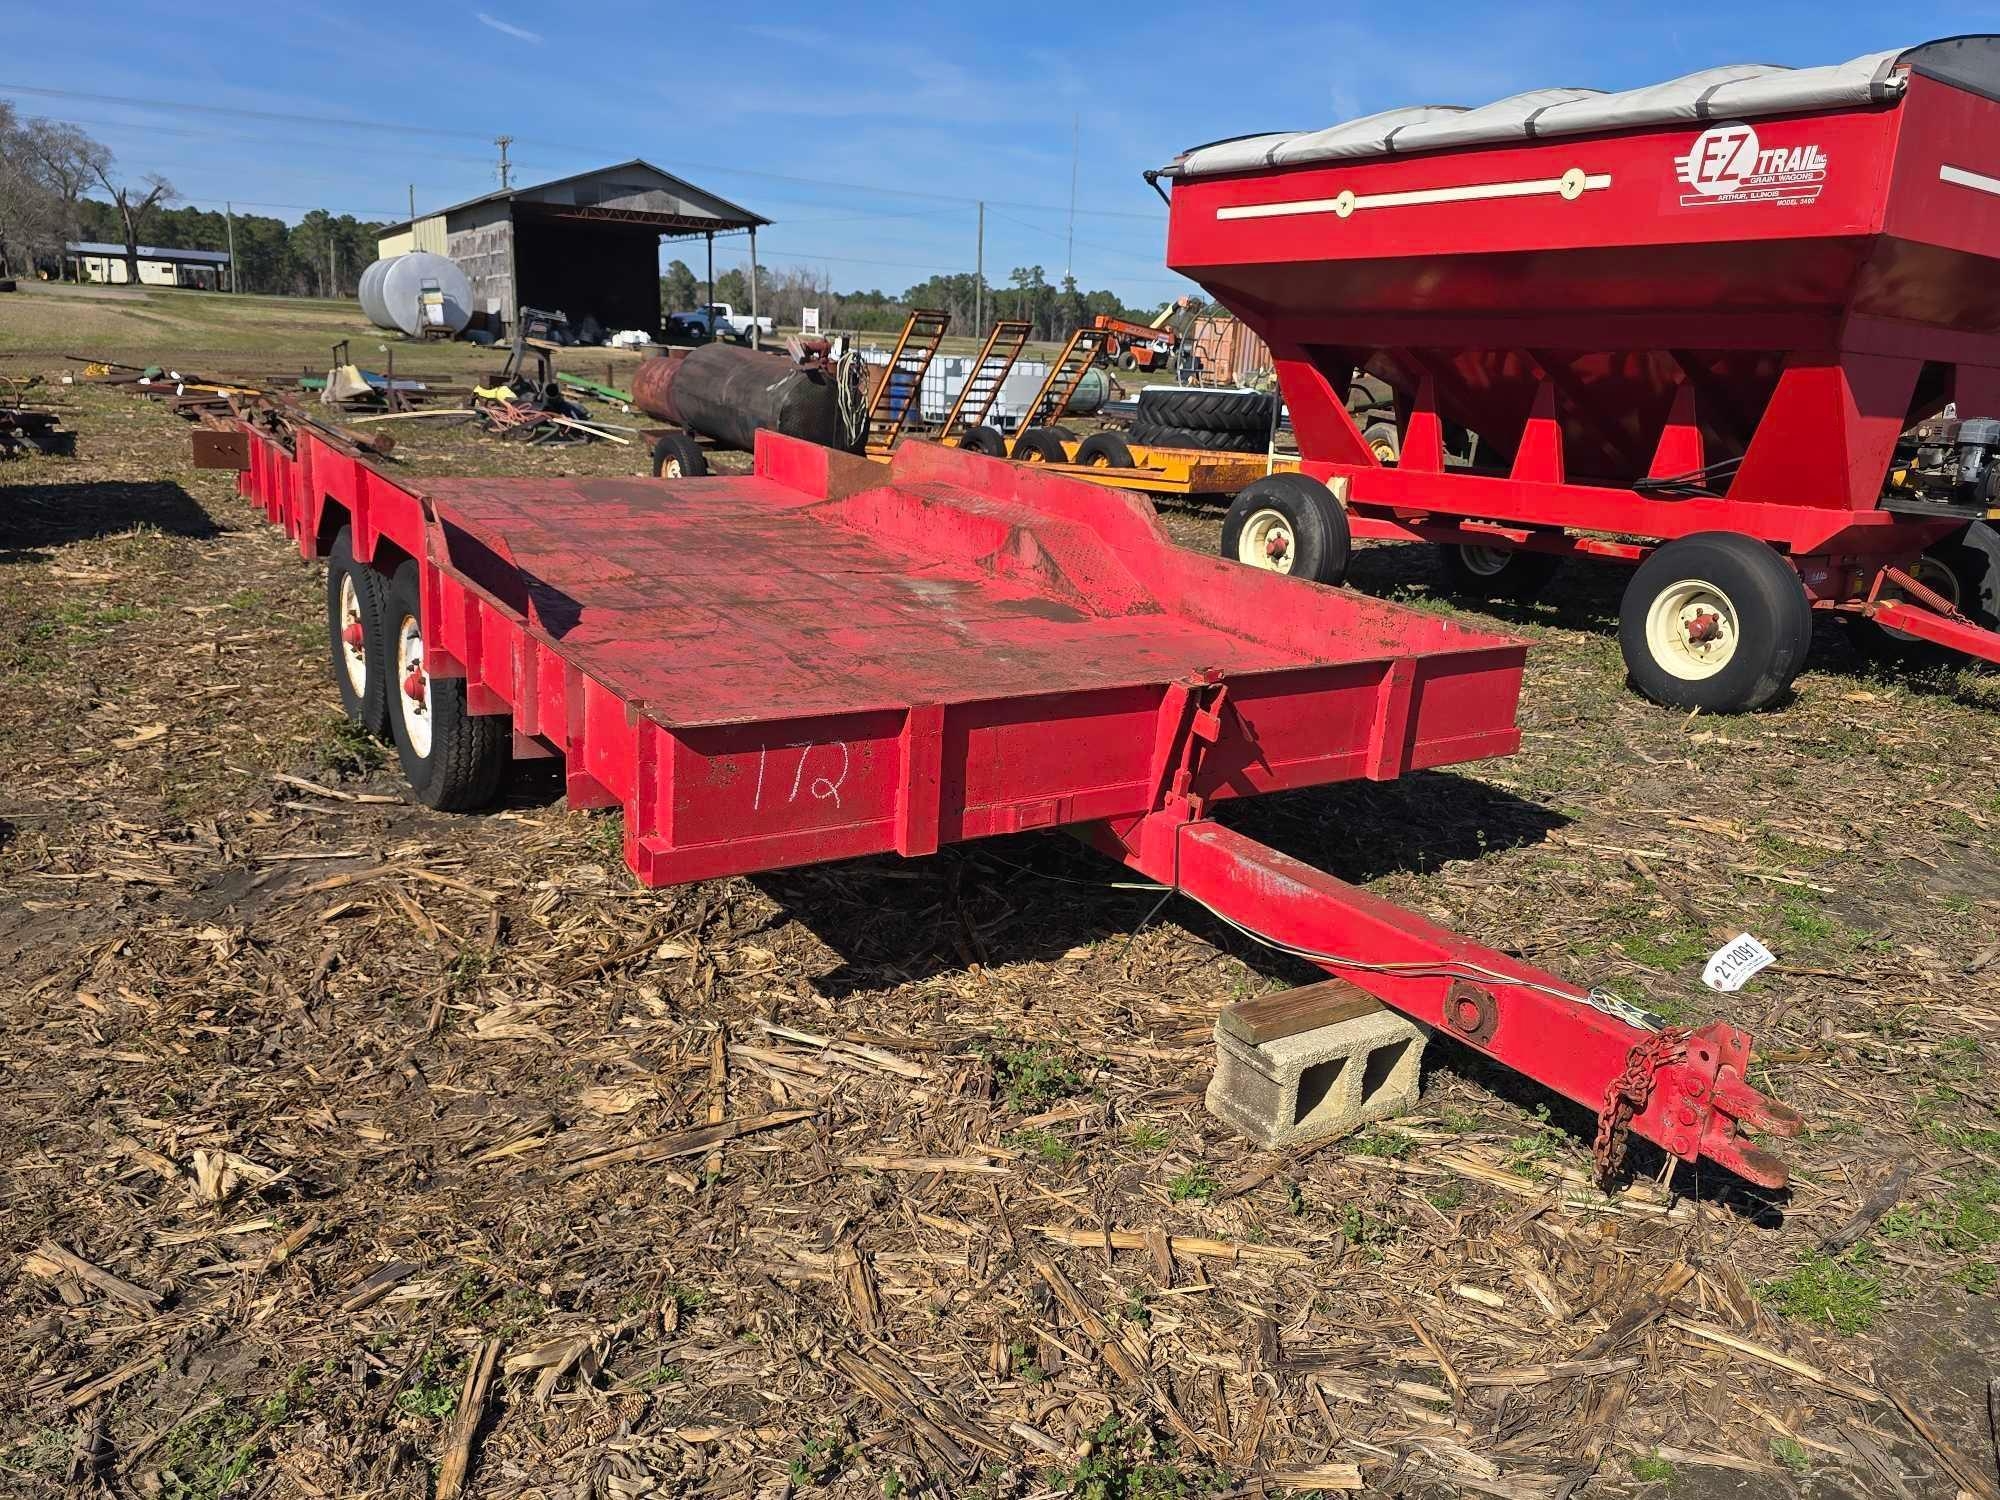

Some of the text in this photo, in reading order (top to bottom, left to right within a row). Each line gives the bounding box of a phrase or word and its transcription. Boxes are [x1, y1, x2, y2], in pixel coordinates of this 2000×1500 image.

[1759, 145, 1827, 174] TRAIL
[1750, 172, 1814, 184] GRAIN WAGONS
[1751, 190, 1779, 199] ILLINOIS
[755, 740, 848, 810] 172
